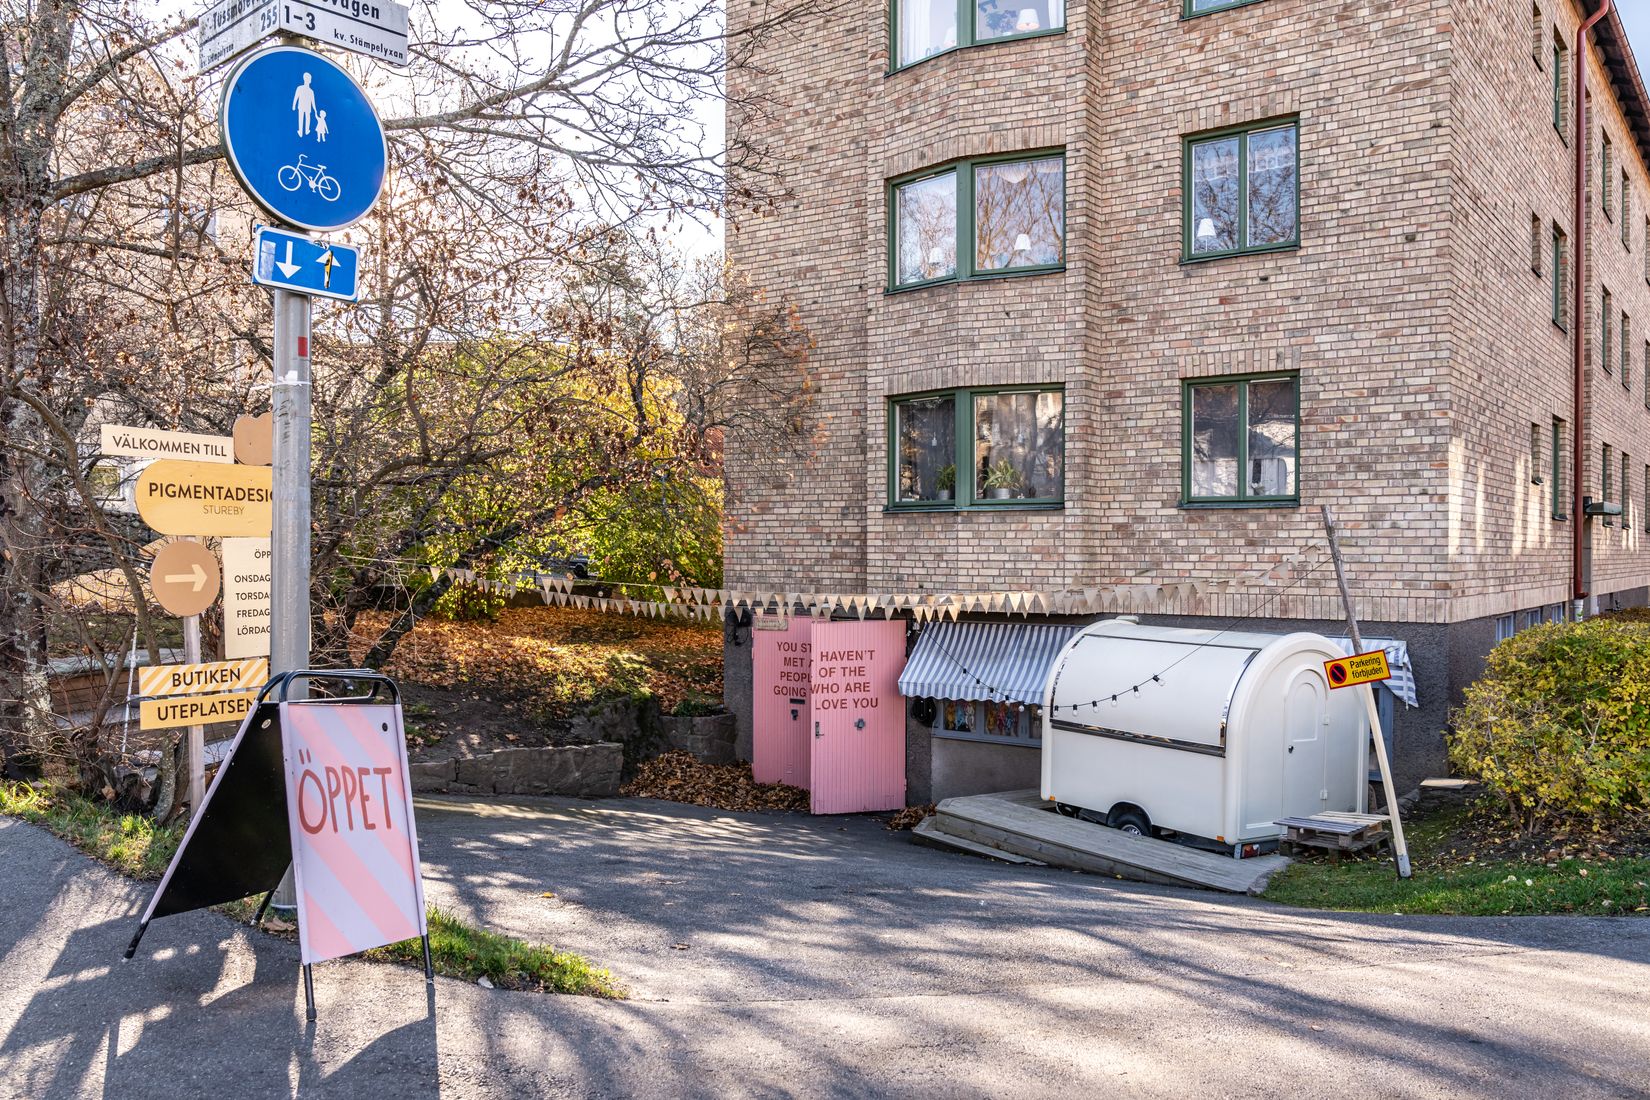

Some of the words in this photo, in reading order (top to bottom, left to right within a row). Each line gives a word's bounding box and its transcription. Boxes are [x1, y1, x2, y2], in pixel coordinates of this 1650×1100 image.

[260, 5, 278, 32] 255
[334, 29, 347, 41] kv.
[350, 34, 404, 59] Stämpelyxan
[112, 433, 201, 455] VÄLKOMMEN
[203, 444, 227, 457] TILL
[149, 482, 273, 503] PIGMENTADESI
[202, 505, 245, 516] STUREBY
[234, 574, 271, 584] ONSDAG
[235, 592, 271, 601] TORSDA
[236, 608, 271, 618] FREDAG
[777, 642, 798, 653] YOU
[783, 657, 805, 667] MET
[820, 650, 875, 662] HAVEN'T
[1350, 657, 1381, 669] Parkering
[172, 668, 241, 687] BUTIKEN
[780, 671, 813, 683] PEOPL
[818, 667, 837, 678] OF
[841, 666, 865, 677] THE
[1352, 666, 1384, 679] förbjuden
[773, 685, 807, 697] GOING
[811, 683, 840, 694] WHO
[844, 682, 870, 693] ARE
[157, 697, 255, 721] UTEPLATSEN
[816, 699, 848, 710] LOVE
[853, 698, 878, 709] YOU
[298, 749, 392, 834] ÖPPET
